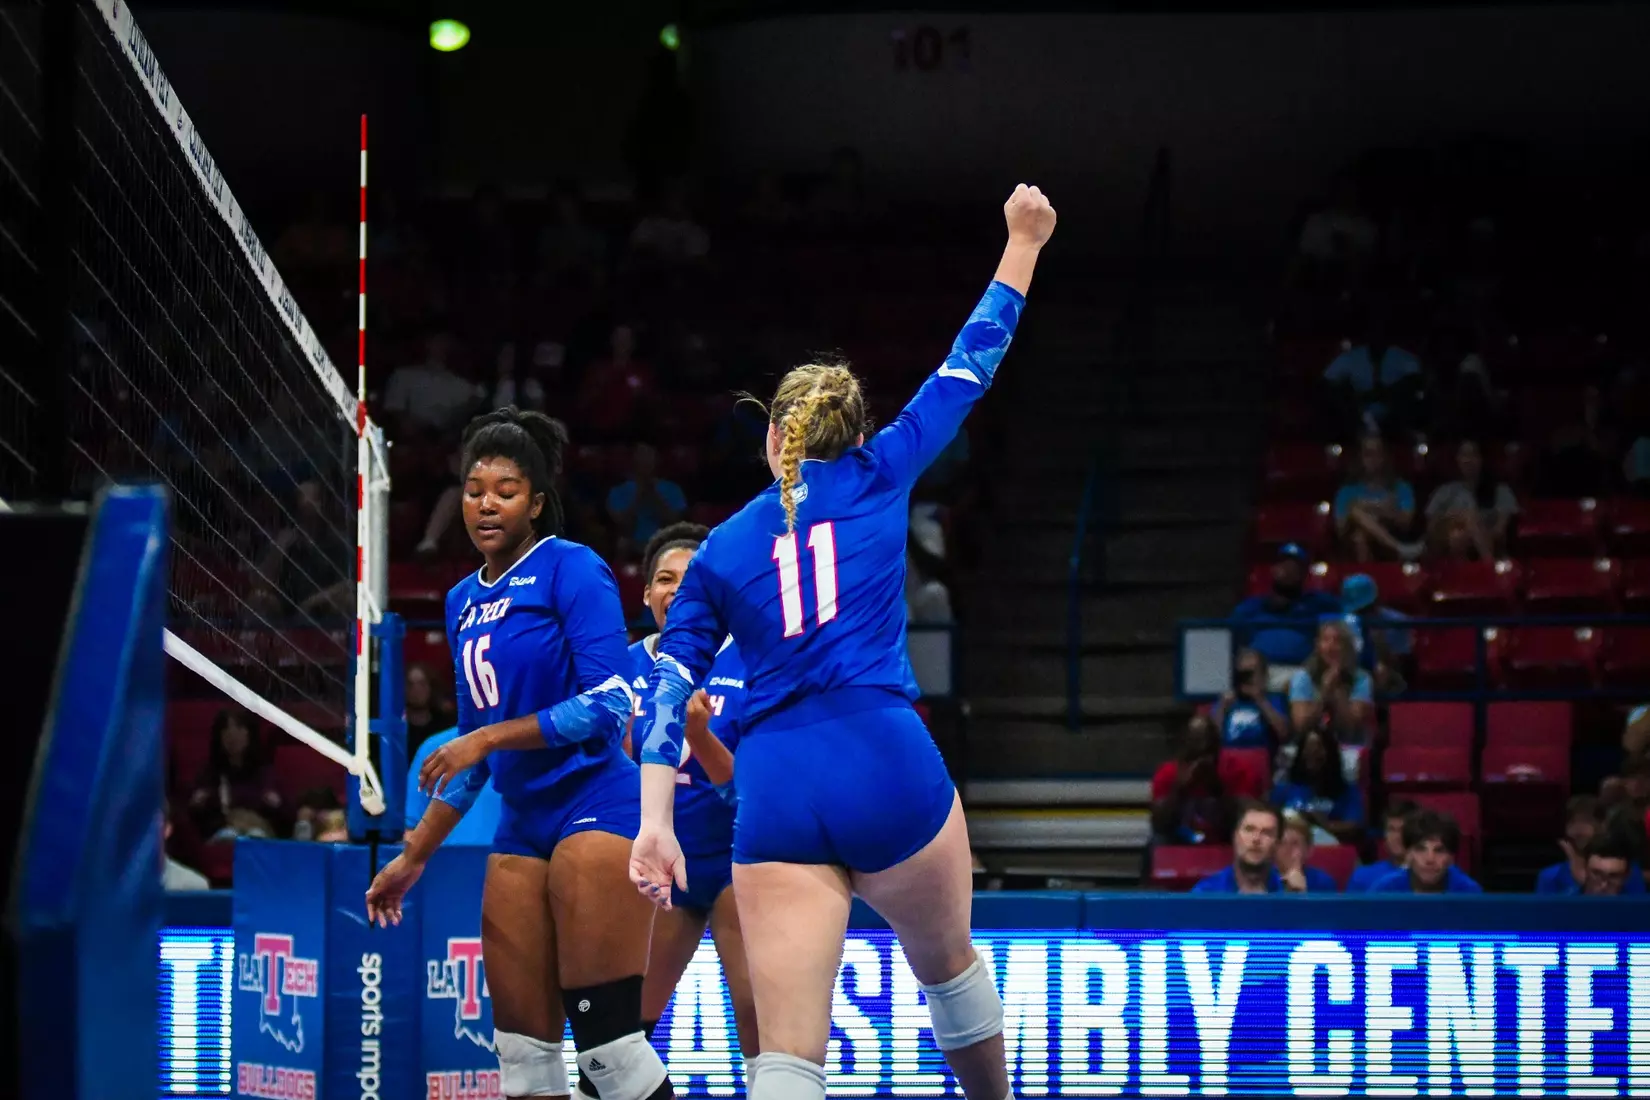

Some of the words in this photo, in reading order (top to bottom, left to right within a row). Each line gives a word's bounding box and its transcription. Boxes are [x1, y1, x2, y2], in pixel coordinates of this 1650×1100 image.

[771, 520, 839, 640] 11
[462, 632, 500, 711] 16
[356, 951, 385, 1037] sports
[236, 1061, 317, 1100] BULLDOGS
[425, 1069, 501, 1100] BULLDO
